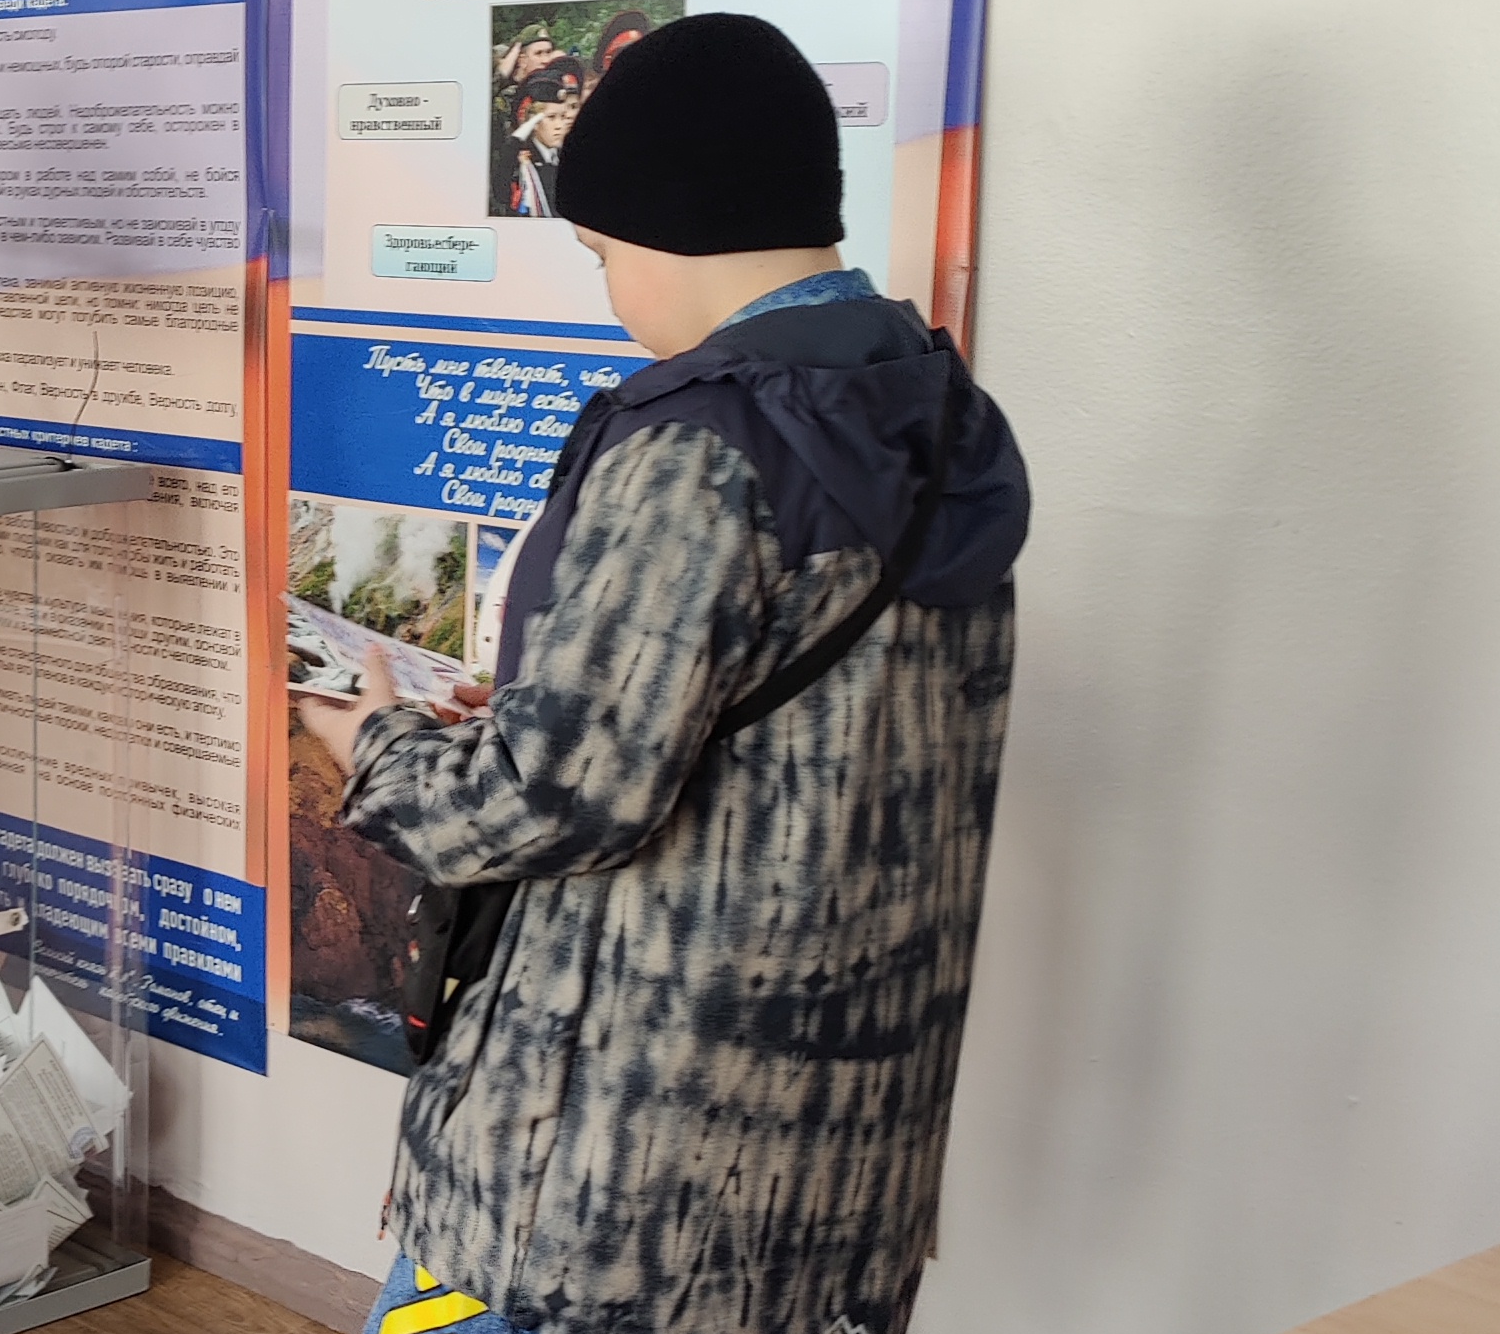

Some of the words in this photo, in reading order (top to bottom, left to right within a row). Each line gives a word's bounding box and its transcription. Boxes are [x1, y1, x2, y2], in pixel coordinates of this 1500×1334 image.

[366, 92, 421, 112] Духовно
[349, 115, 443, 136] нравственный
[362, 344, 427, 379] Пусть
[428, 358, 471, 378] мне
[578, 365, 622, 390] что
[415, 372, 455, 402] Что
[475, 386, 529, 417] мире
[530, 389, 583, 414] есть
[414, 399, 440, 426] А
[438, 410, 457, 428] я
[458, 404, 525, 435] люблю
[442, 426, 488, 457] Свои
[412, 450, 441, 477] А
[439, 462, 456, 479] я
[458, 461, 525, 487] люблю
[440, 478, 487, 508] Свои
[158, 907, 243, 953] достойном,
[162, 940, 243, 984] правилами
